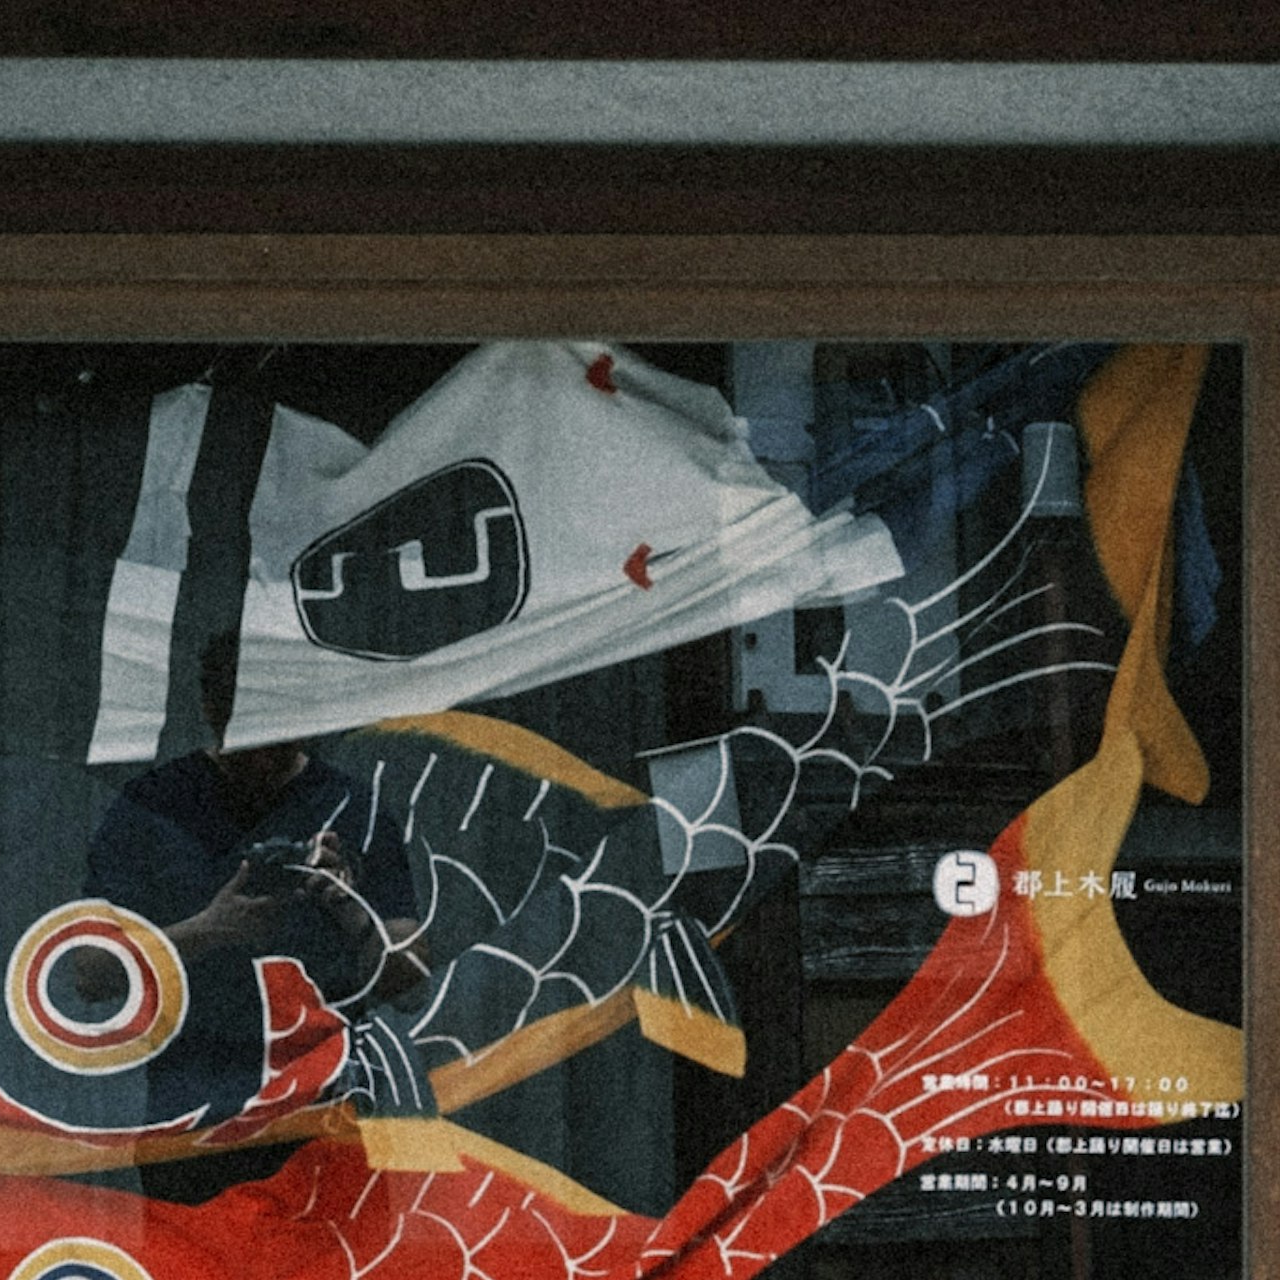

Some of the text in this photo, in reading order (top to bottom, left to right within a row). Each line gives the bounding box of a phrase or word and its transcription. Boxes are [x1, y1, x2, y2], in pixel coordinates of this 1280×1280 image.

[1013, 870, 1137, 899] 郡上木履
[1144, 879, 1232, 895] Gujo Mokuri
